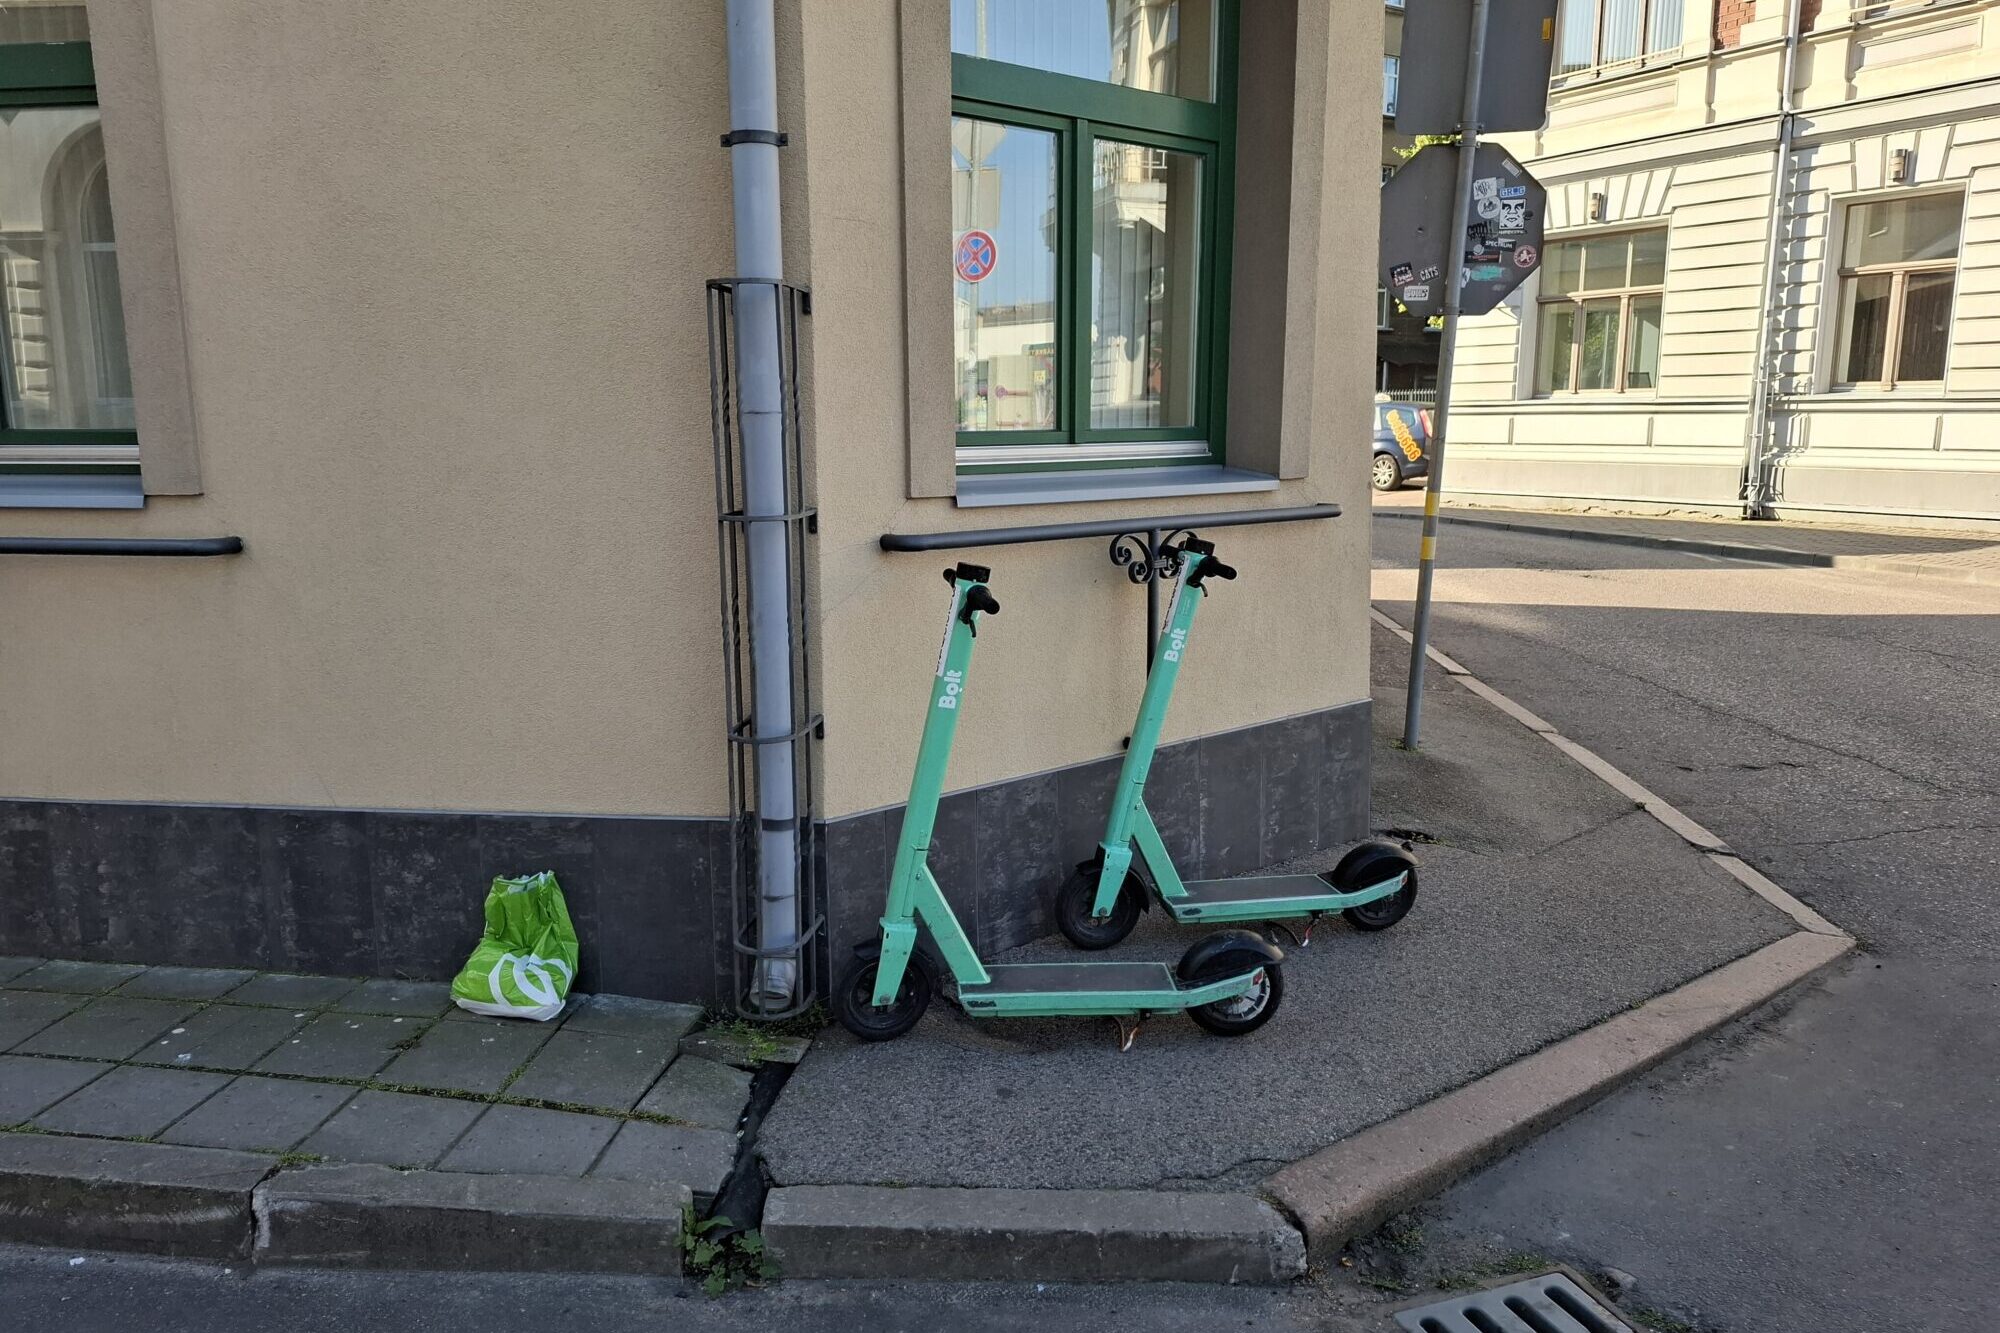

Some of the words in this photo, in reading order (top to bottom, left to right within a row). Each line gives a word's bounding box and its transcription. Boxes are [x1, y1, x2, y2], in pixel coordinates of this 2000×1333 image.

[1419, 266, 1439, 281] CATS
[1163, 628, 1187, 662] Bolt
[938, 670, 962, 709] Bolt
